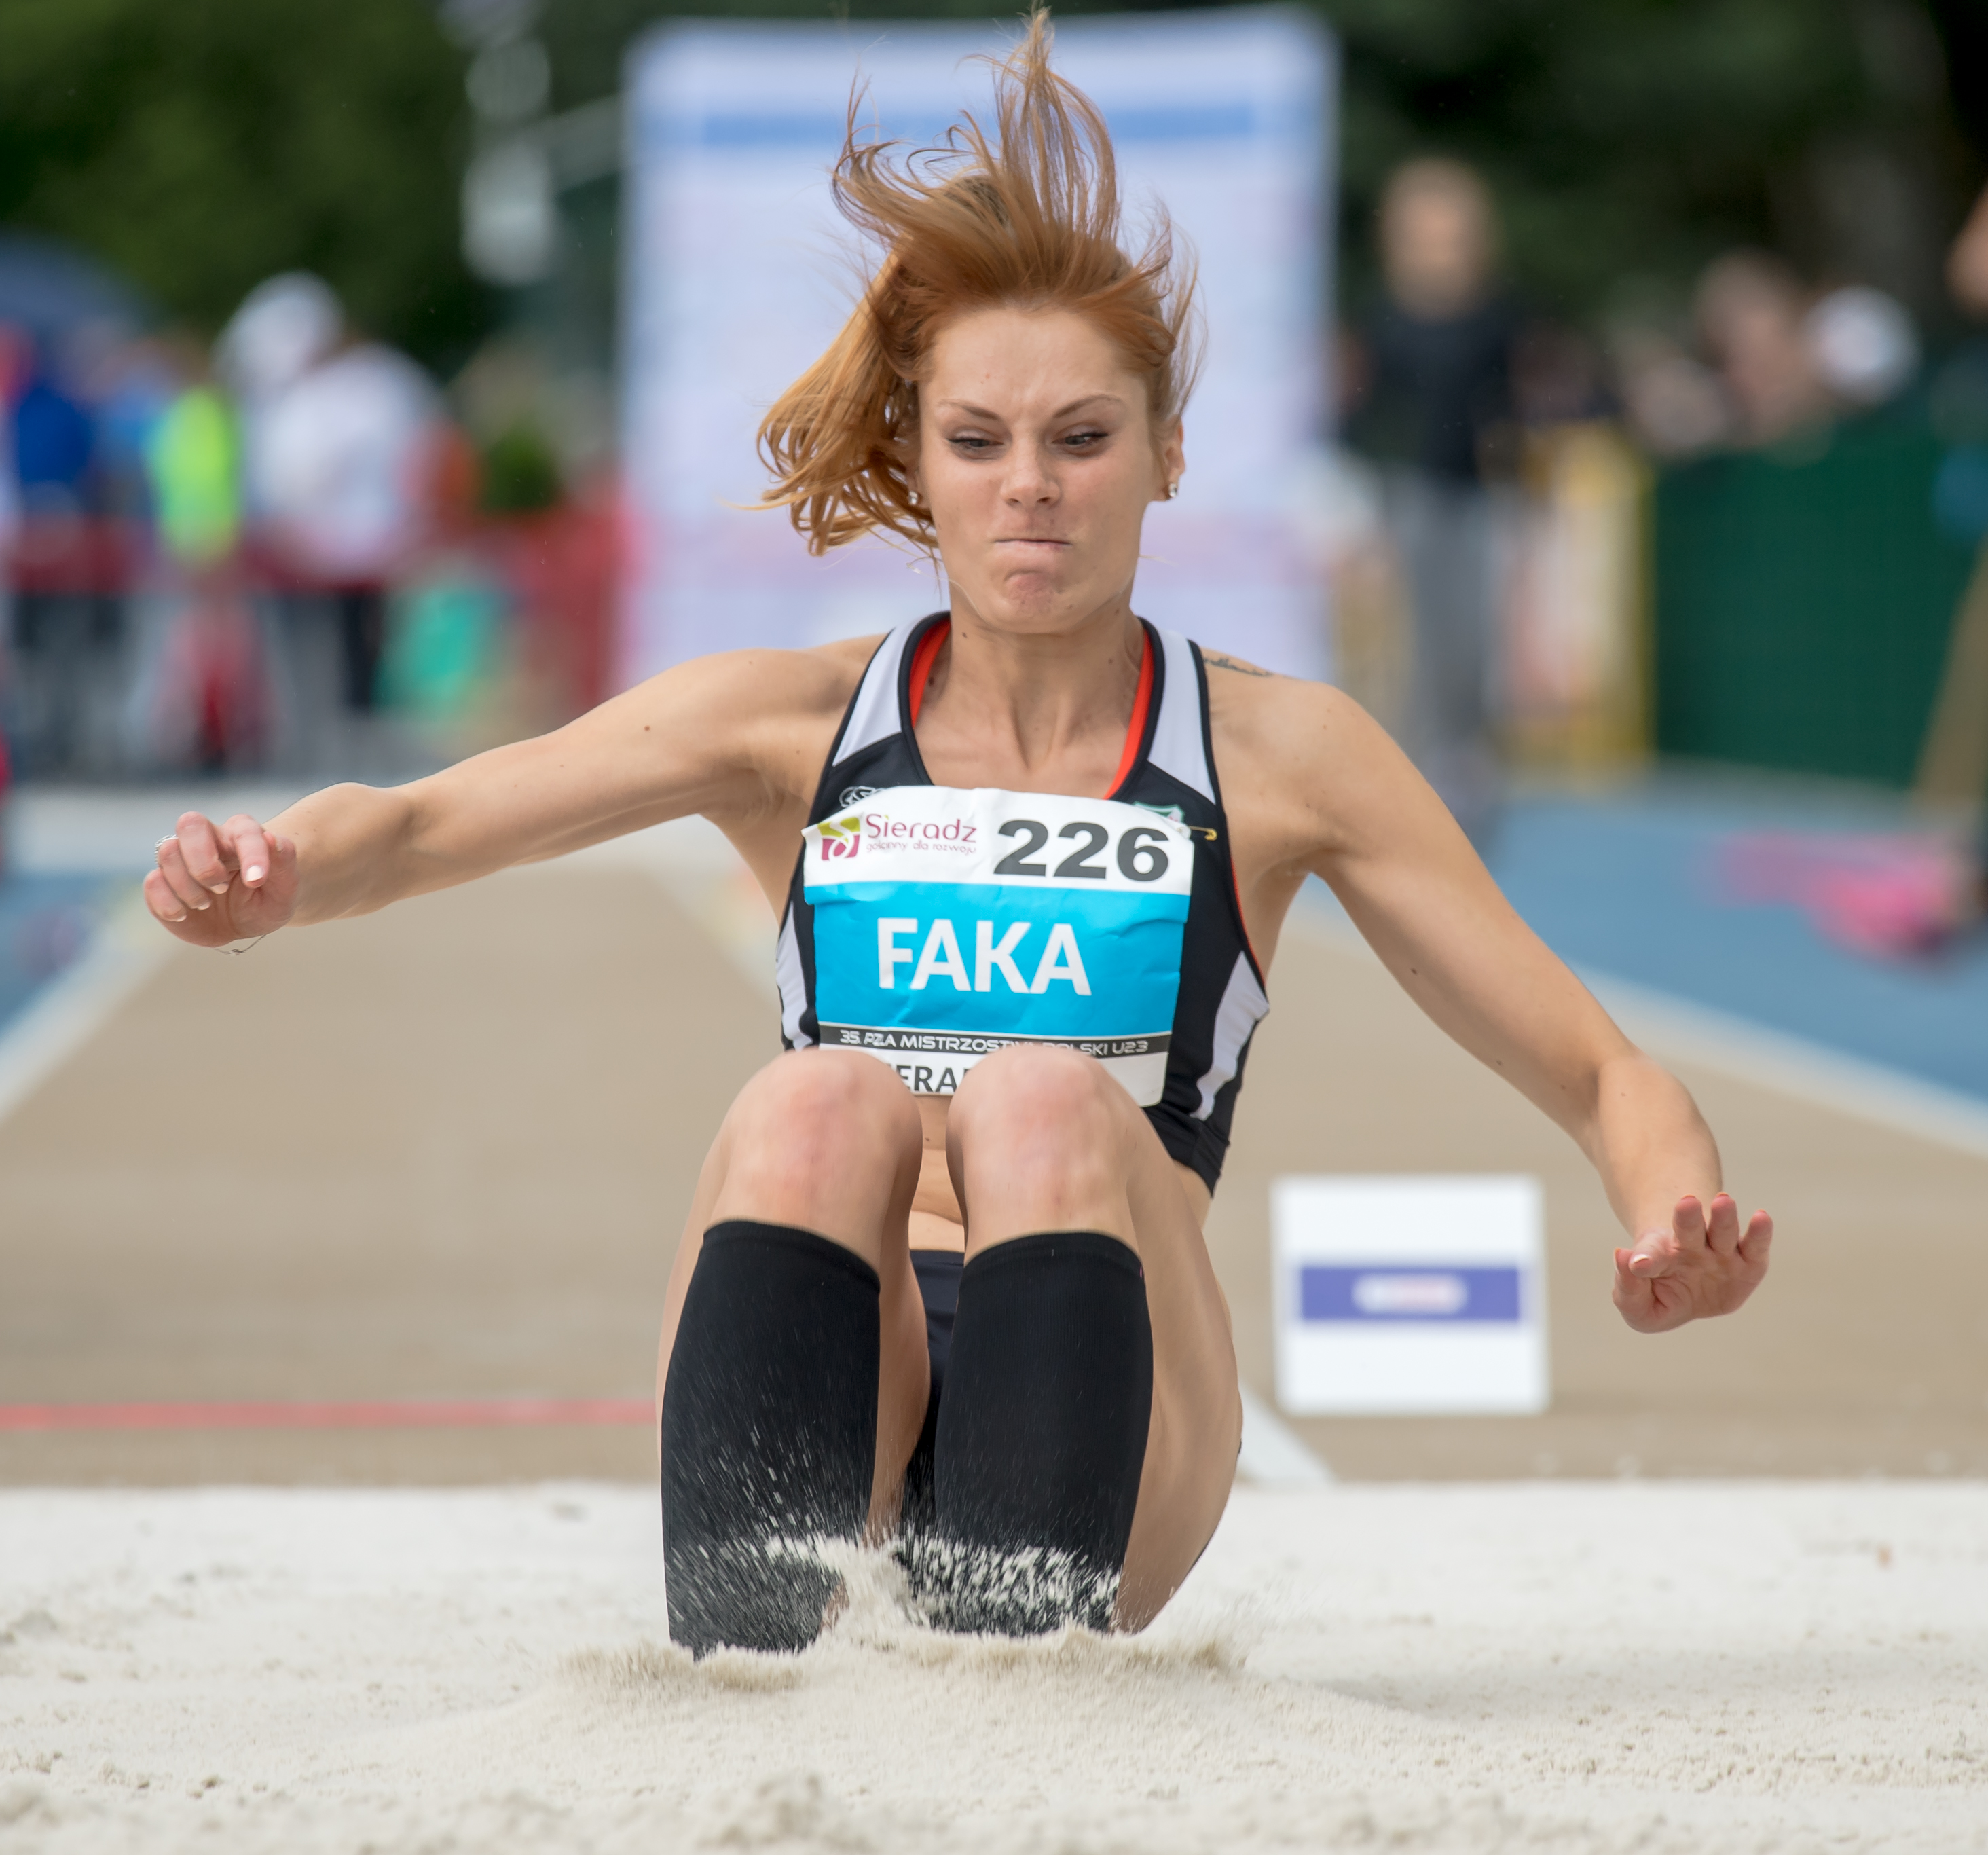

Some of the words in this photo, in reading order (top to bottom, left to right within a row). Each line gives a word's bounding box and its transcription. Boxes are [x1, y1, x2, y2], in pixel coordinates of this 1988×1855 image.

[866, 814, 977, 843] Sieradz
[913, 839, 929, 851] dla
[933, 843, 977, 856] rozwoju
[993, 819, 1169, 882] 226
[877, 917, 1092, 996] FAKA
[900, 1034, 1033, 1052] MISTRZOST
[1112, 1040, 1149, 1054] U23
[885, 1063, 972, 1093] ERA
